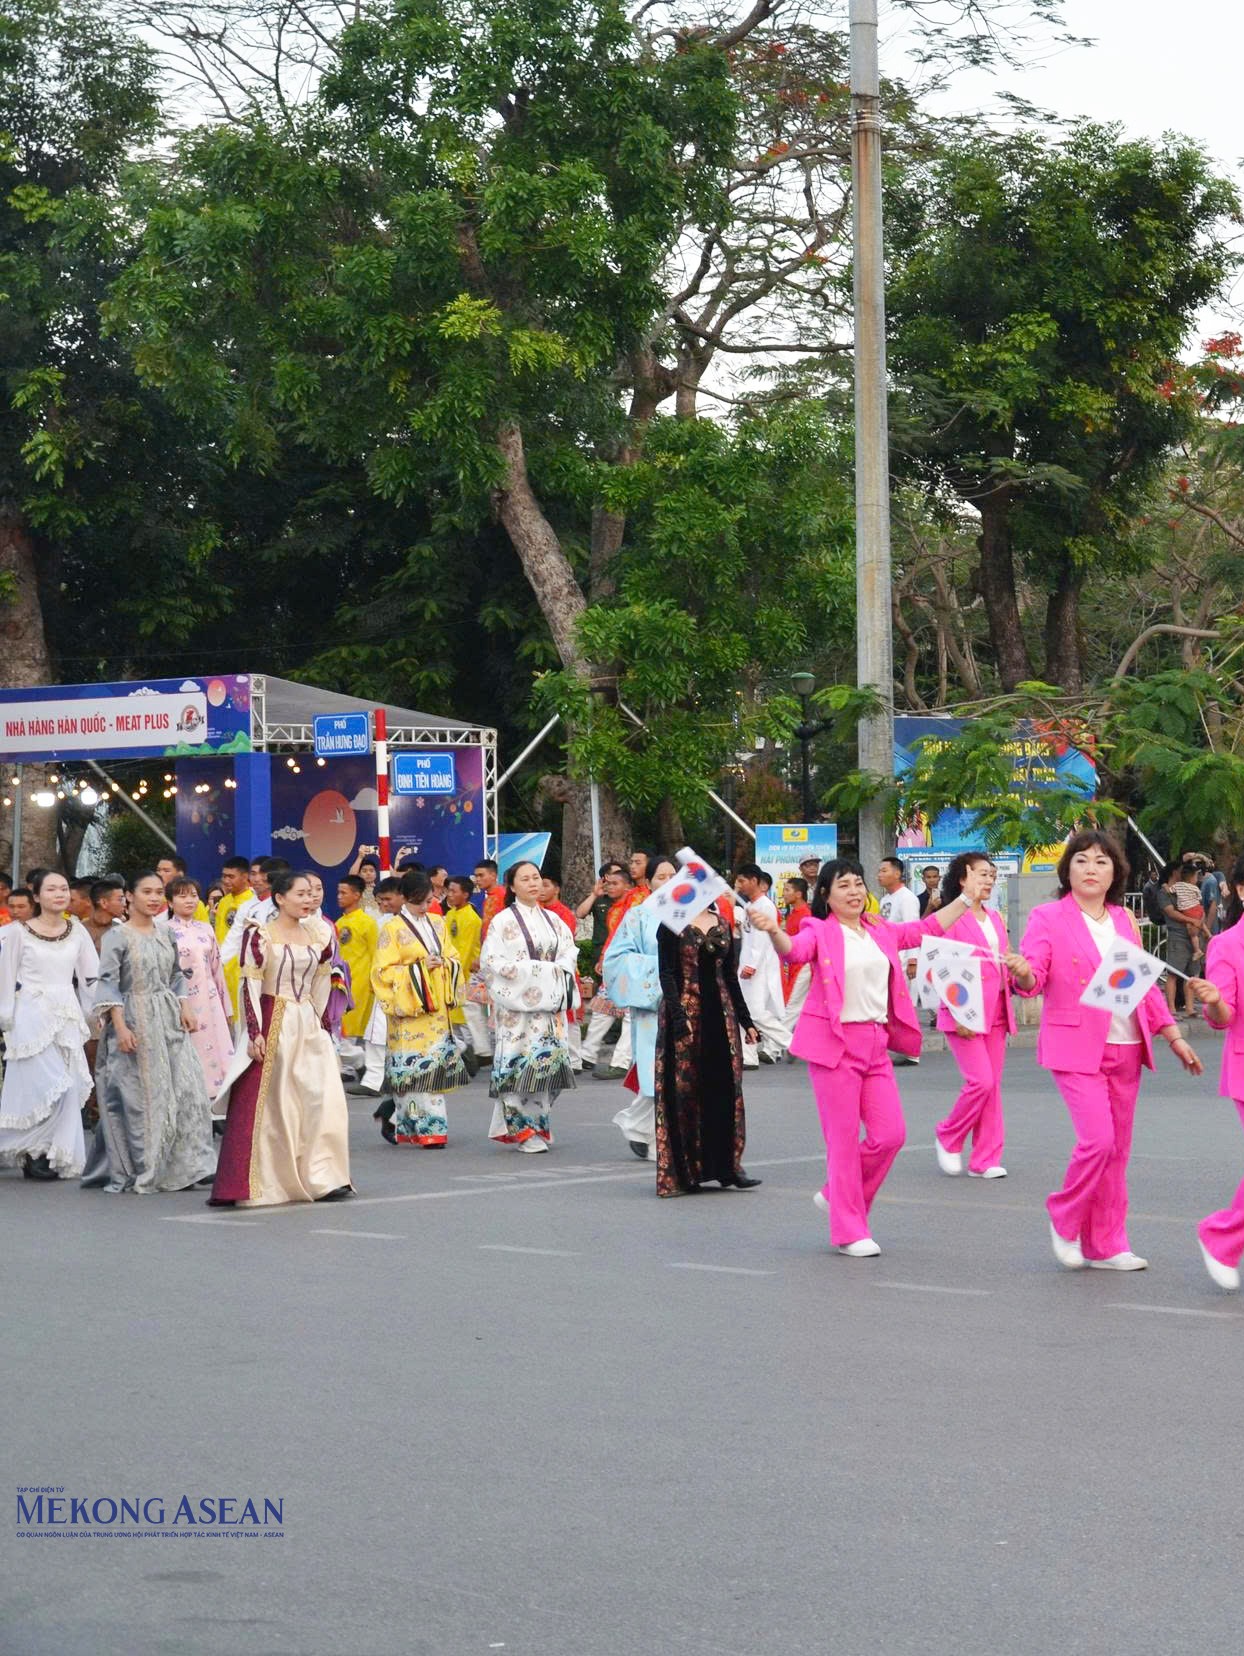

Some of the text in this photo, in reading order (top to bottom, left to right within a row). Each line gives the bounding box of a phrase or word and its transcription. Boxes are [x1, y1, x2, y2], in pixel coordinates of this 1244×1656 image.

[6, 718, 26, 737] NHÀ
[28, 716, 55, 736] HÀNG
[57, 715, 78, 735] HÀN
[80, 712, 106, 734] QUỐC
[116, 714, 141, 732] MEAT
[144, 713, 169, 730] PLUS
[334, 718, 347, 729] PHỐ
[317, 732, 366, 751] TRẦN HƯNG ĐẠO
[417, 757, 431, 768] PHỐ
[398, 771, 452, 788] ĐINH TIÊN HOÀNG
